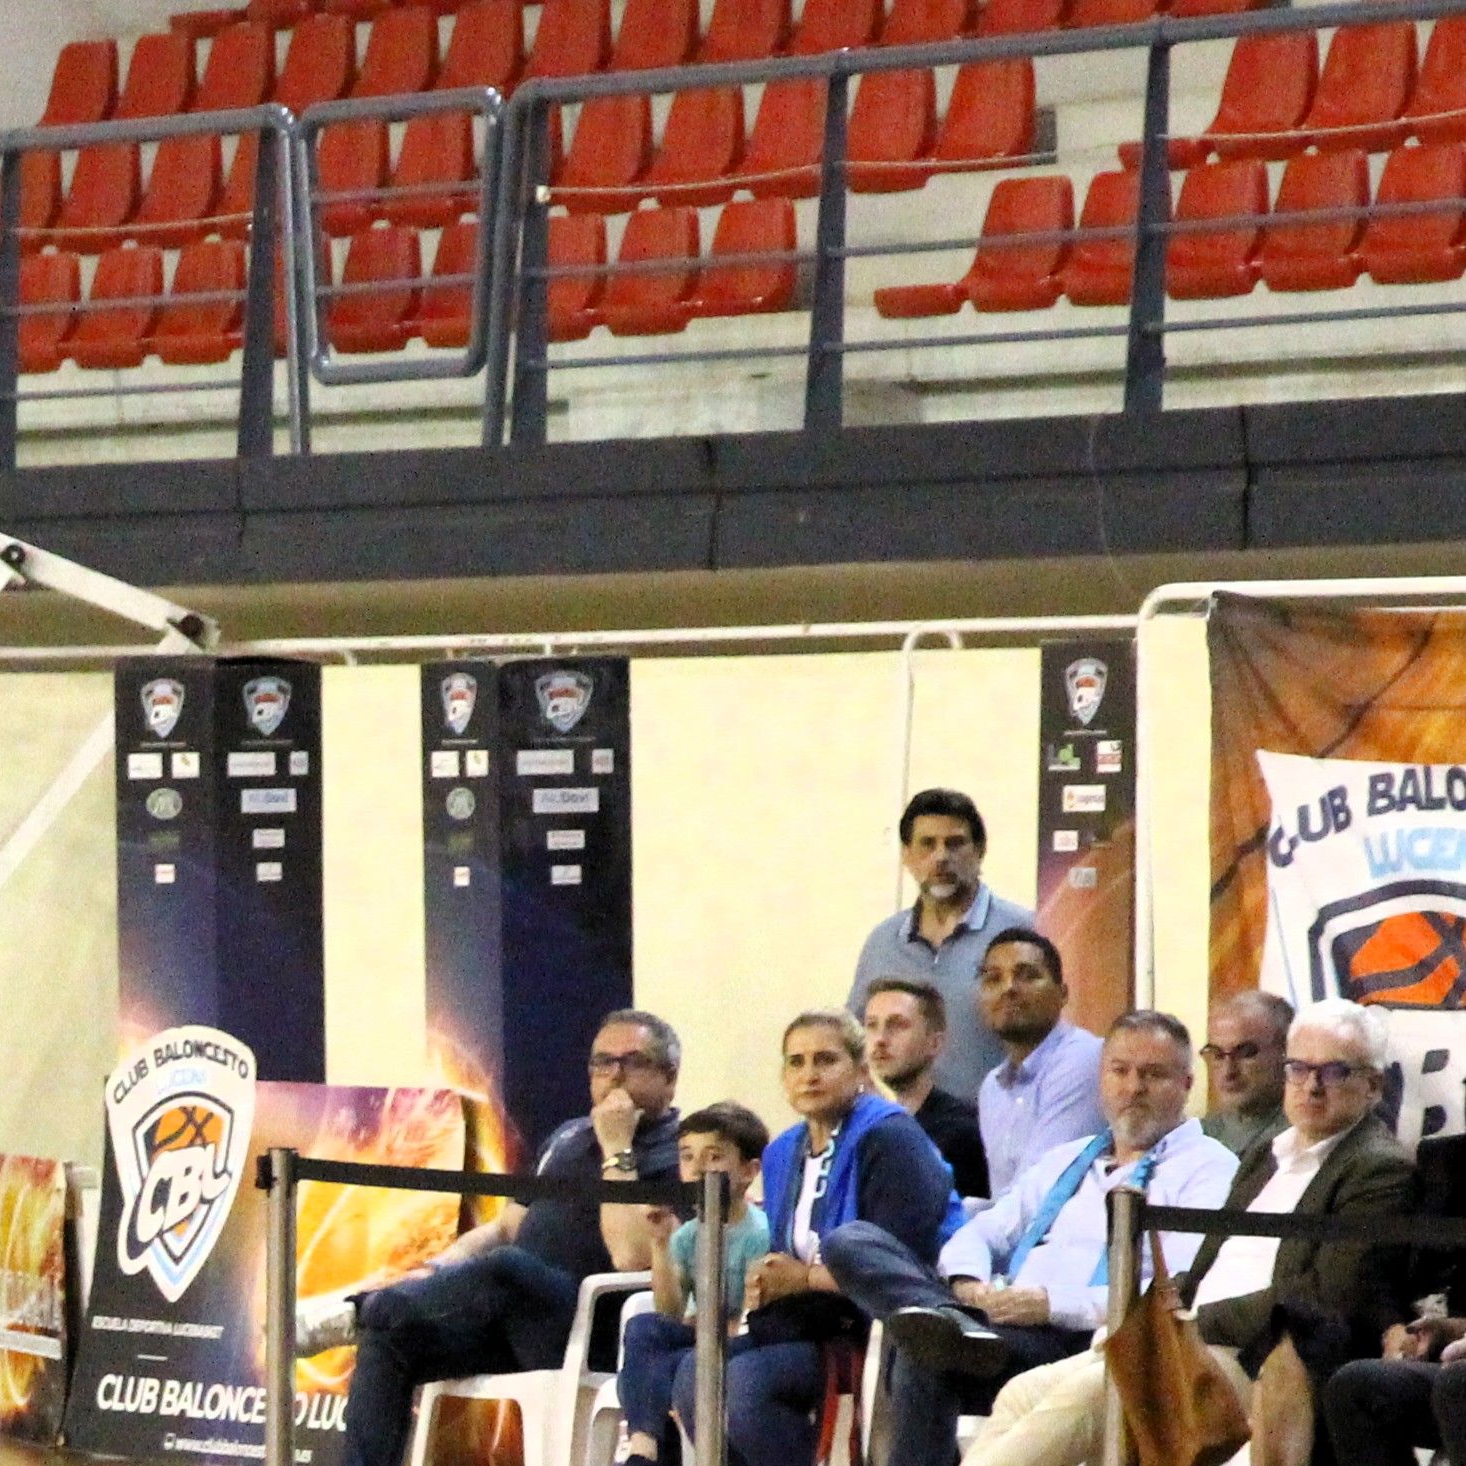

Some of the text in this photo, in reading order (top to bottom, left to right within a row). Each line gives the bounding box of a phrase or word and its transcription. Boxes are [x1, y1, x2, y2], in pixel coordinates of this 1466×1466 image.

[113, 1039, 249, 1104] CLUB BALONCESTO
[136, 1143, 231, 1243] CBL
[96, 1373, 160, 1414] CLUB
[159, 1379, 308, 1426] BALONCEO
